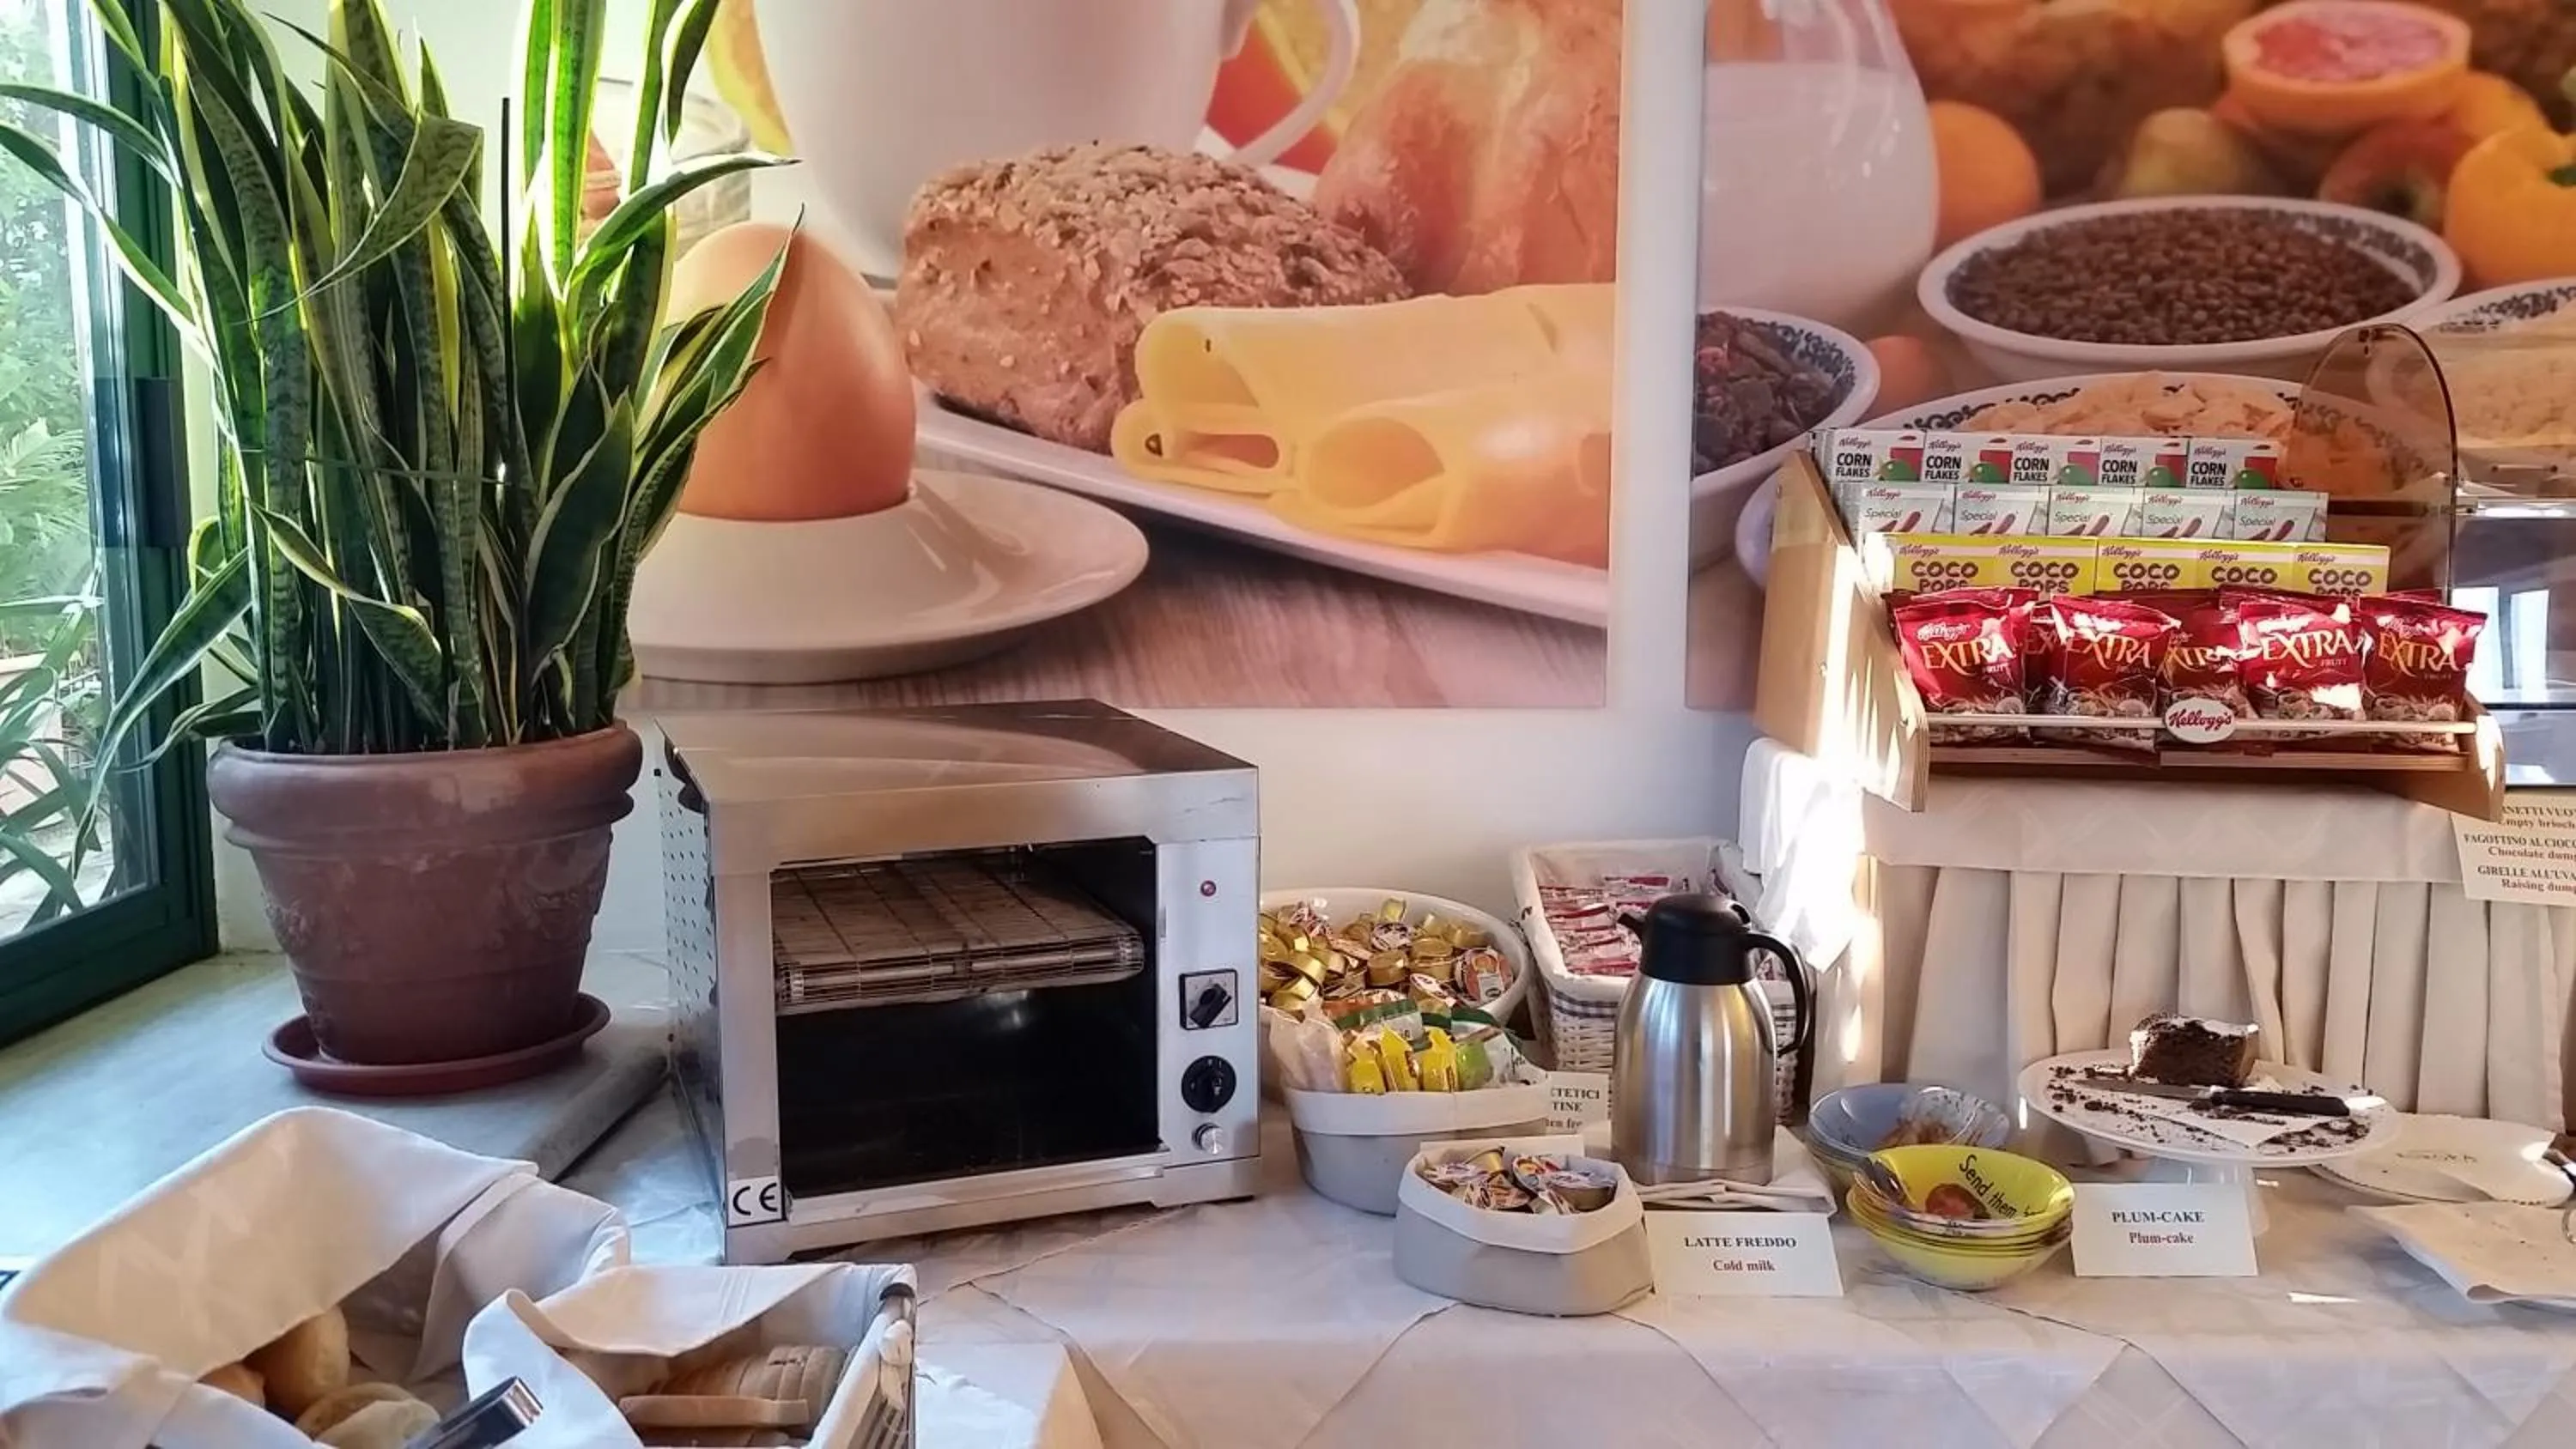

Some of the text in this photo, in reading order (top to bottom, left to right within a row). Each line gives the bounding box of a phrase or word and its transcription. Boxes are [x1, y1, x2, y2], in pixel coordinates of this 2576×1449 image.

[1837, 453, 1873, 466] CORN
[1926, 456, 1962, 469] CORN
[2014, 458, 2050, 470] CORN
[2103, 459, 2137, 472] CORN
[1836, 468, 1870, 478] FLAKES
[2190, 462, 2227, 475] CORN
[1924, 470, 1959, 480] FLAKES
[2014, 471, 2048, 482] FLAKES
[2101, 473, 2136, 483] FLAKES
[2190, 476, 2225, 486] FLAKES
[1865, 508, 1902, 518] Special
[1961, 509, 1997, 520] Special
[2054, 511, 2091, 522] Special
[2147, 514, 2183, 524] Special
[2239, 516, 2275, 526] Special
[1911, 561, 1978, 578] COCO
[2010, 561, 2080, 579] COCO
[2113, 562, 2180, 579] COCO
[2211, 566, 2278, 584] COCO
[2308, 568, 2372, 586] COCO
[1919, 632, 2016, 676] EXTRA
[2261, 629, 2358, 669] EXTRA
[2379, 630, 2459, 678] EXTRA
[2168, 708, 2233, 731] Kellogg's
[2488, 846, 2544, 858] Chocolate
[2477, 865, 2528, 877] GIRELLE
[1959, 1154, 2018, 1220] Send them
[732, 1182, 778, 1216] CE
[2111, 1211, 2205, 1223] PLUM-CAKE
[1684, 1237, 1797, 1248] LATTE FREDDO
[2129, 1231, 2195, 1244] Plum-cake
[1713, 1259, 1776, 1271] Cold milk
